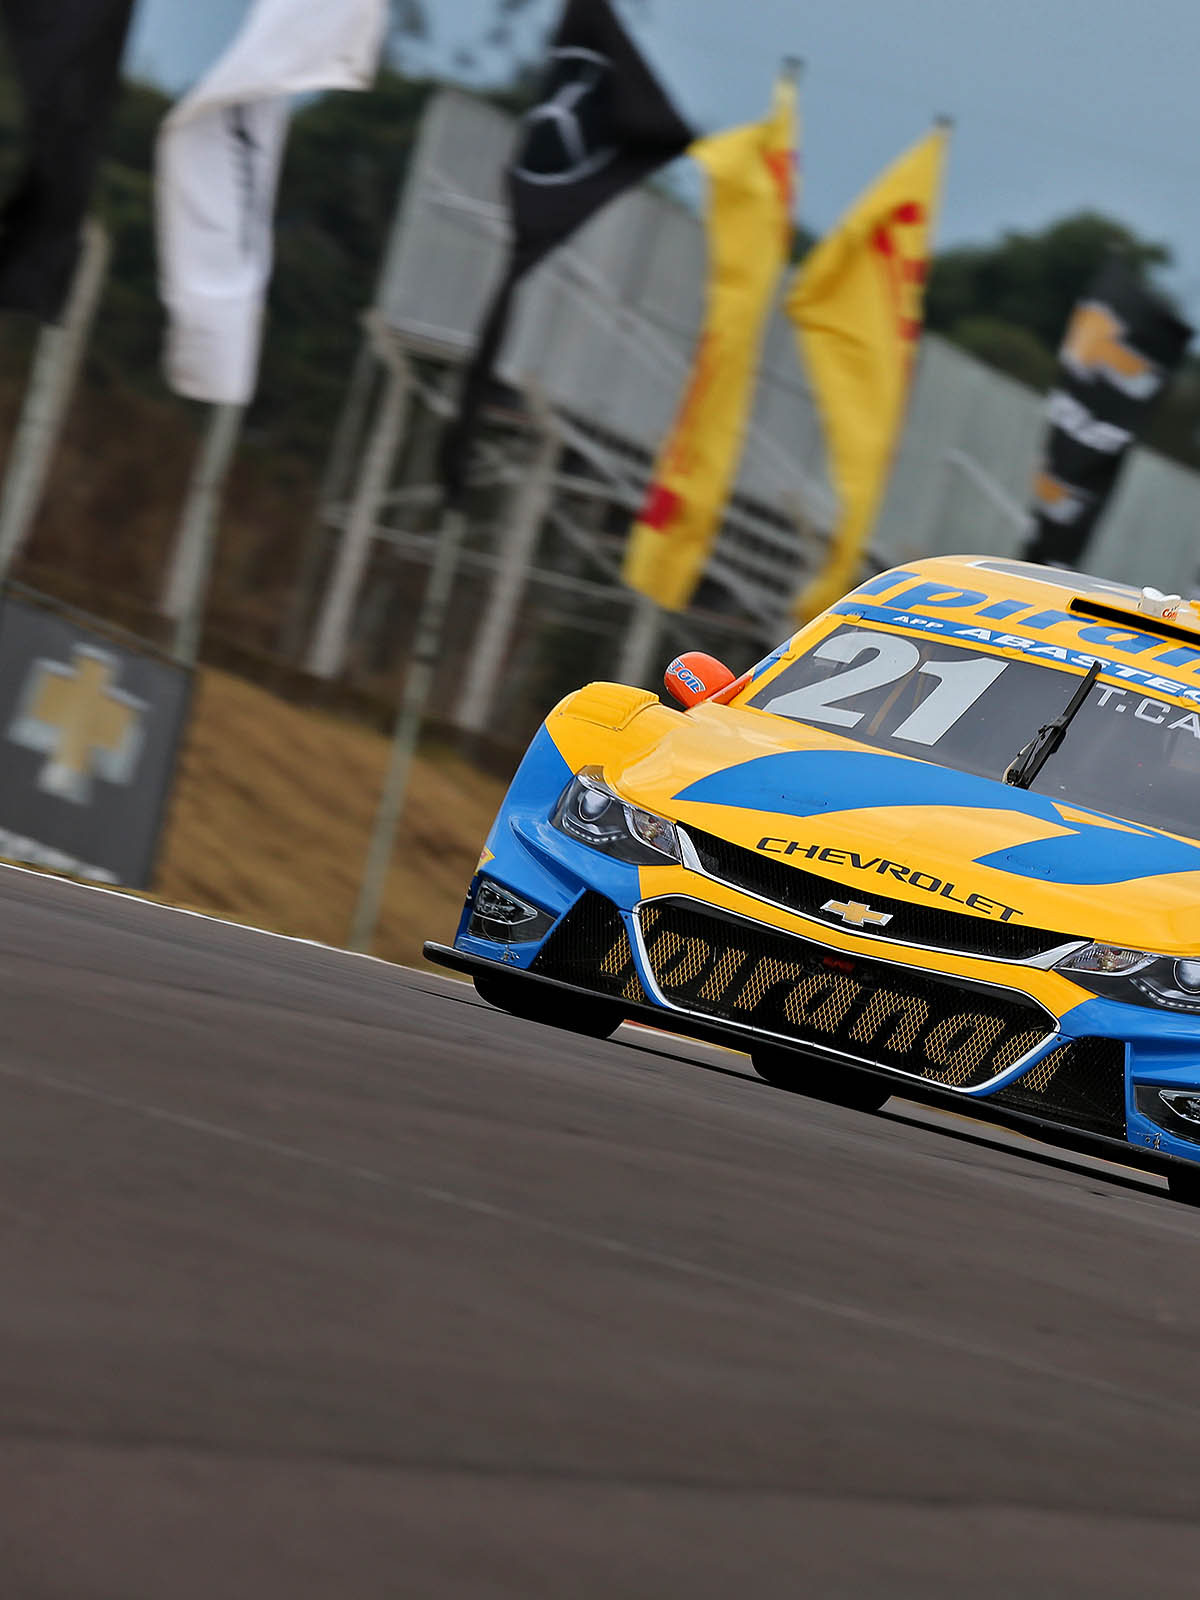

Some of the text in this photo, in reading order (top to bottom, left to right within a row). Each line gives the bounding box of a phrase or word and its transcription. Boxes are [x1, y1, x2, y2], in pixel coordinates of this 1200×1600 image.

[893, 615, 944, 630] APP
[762, 631, 1010, 747] 21
[756, 837, 1024, 922] CHEVROLET
